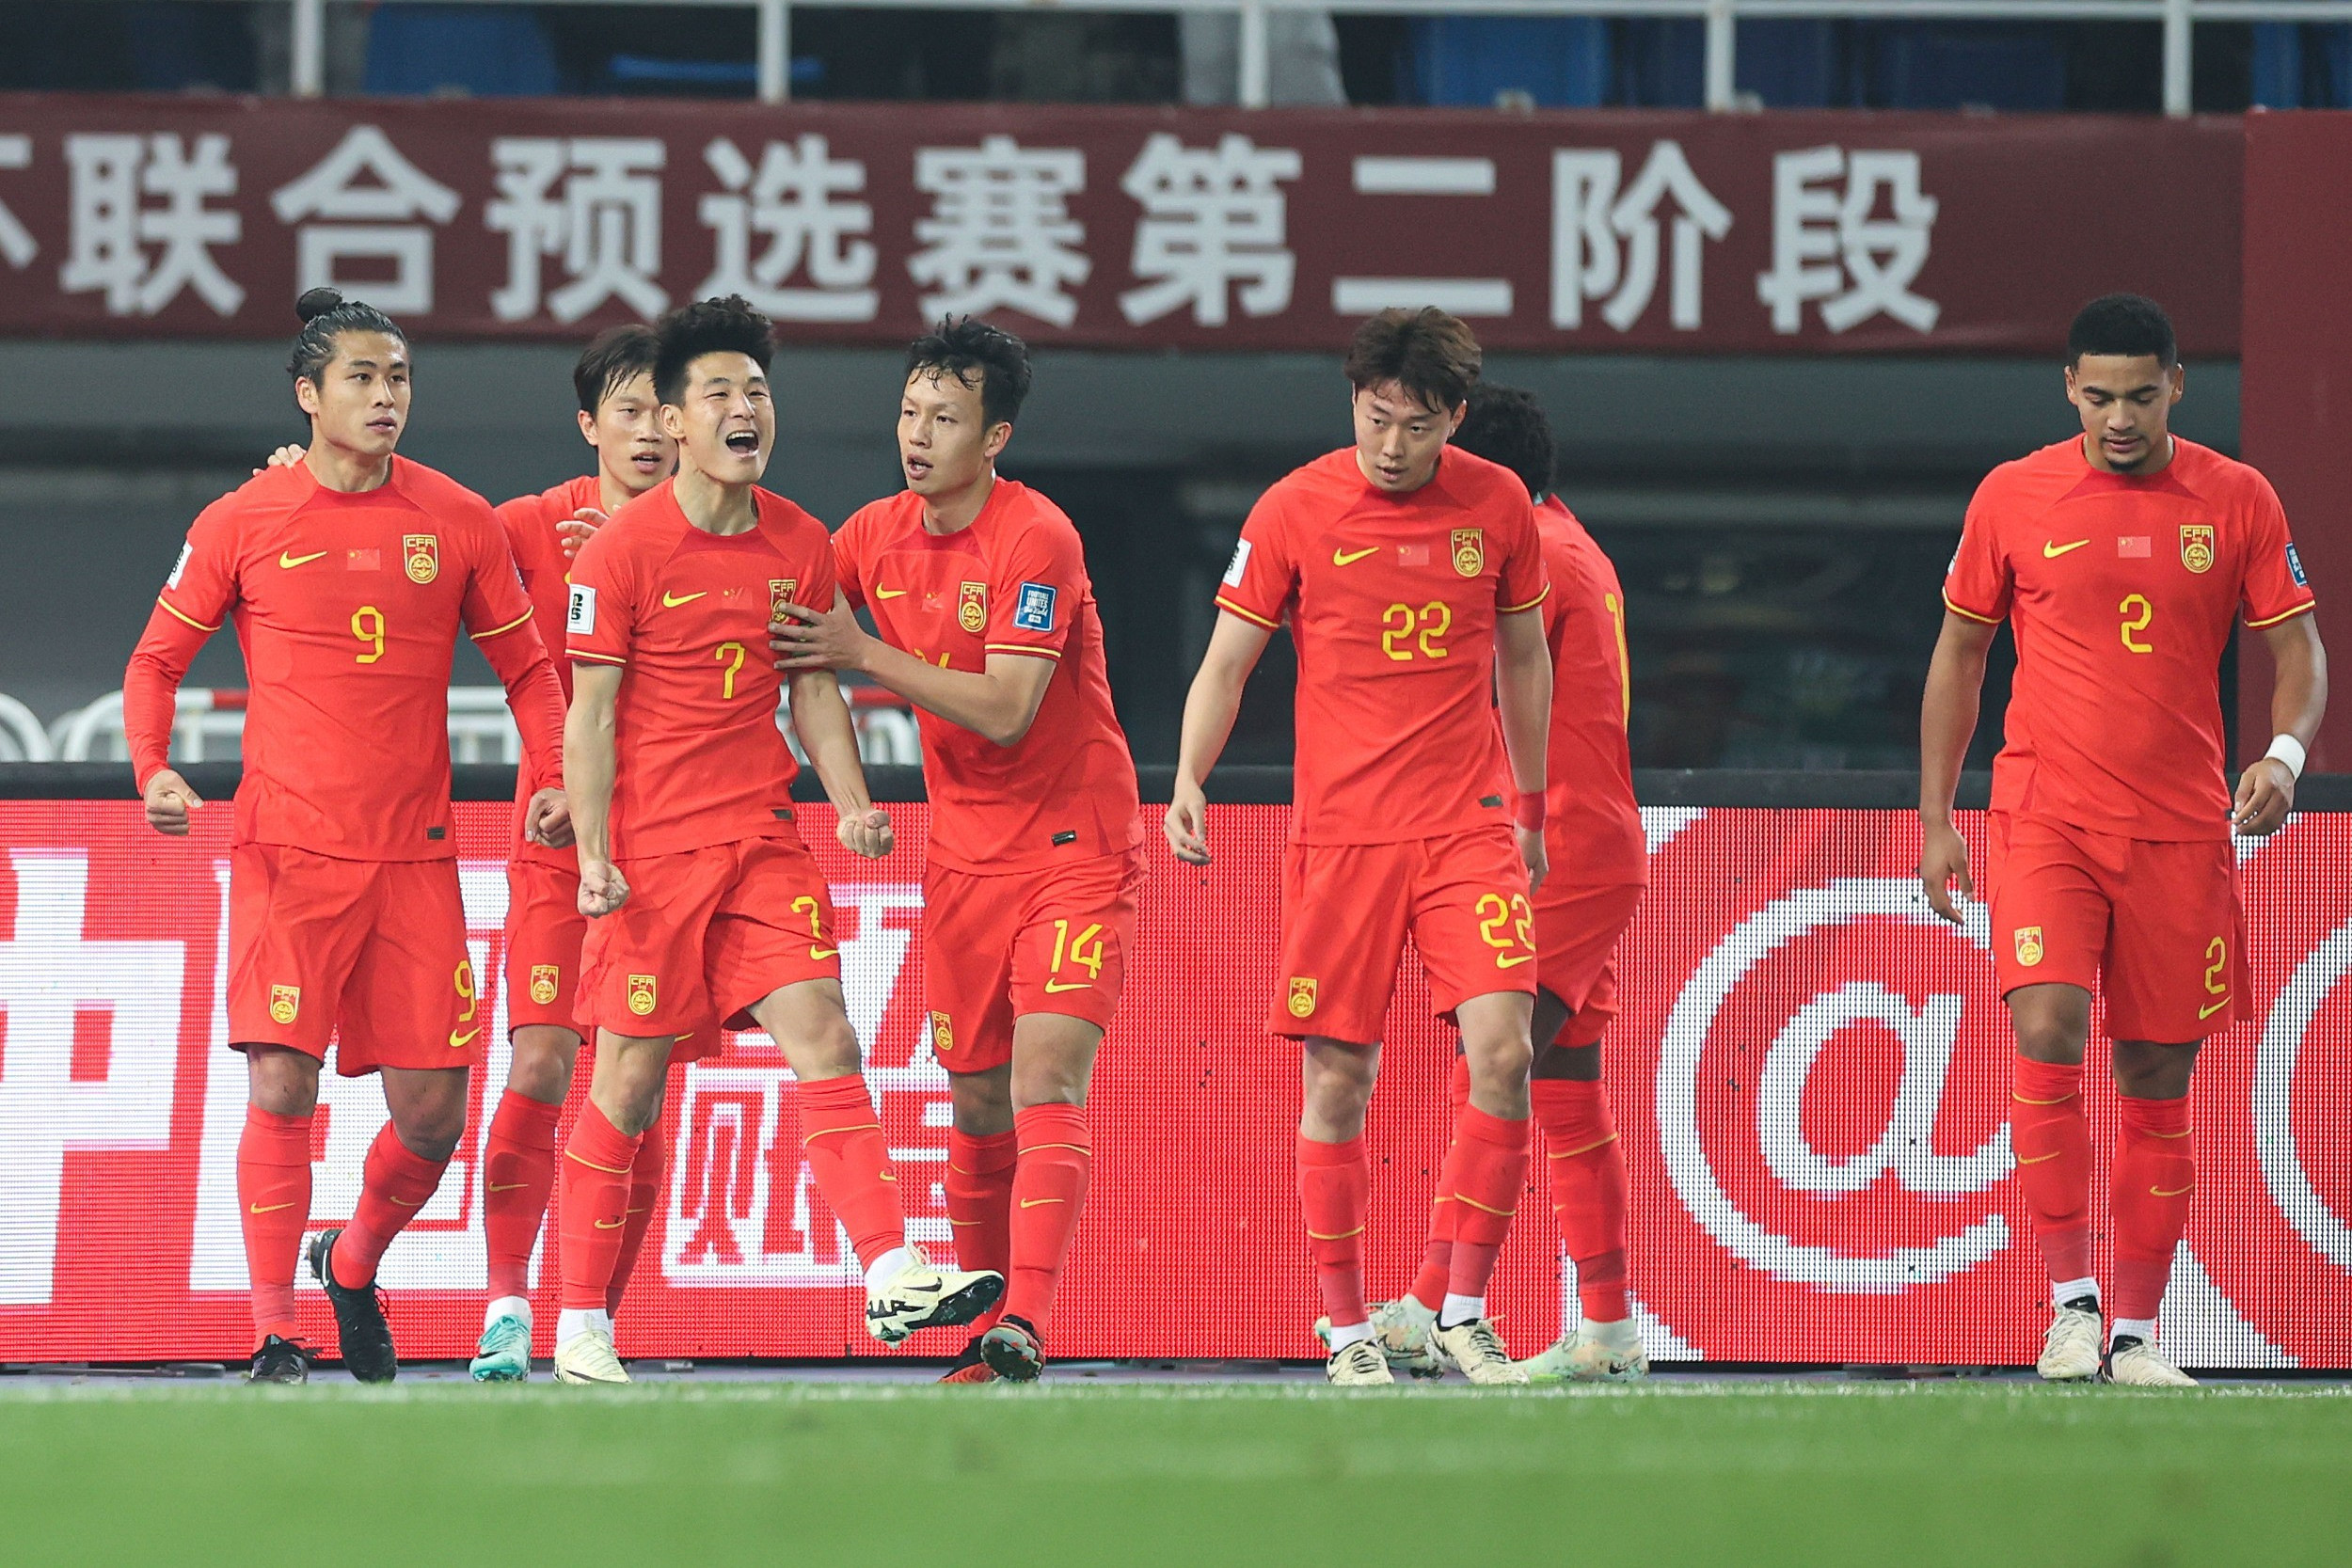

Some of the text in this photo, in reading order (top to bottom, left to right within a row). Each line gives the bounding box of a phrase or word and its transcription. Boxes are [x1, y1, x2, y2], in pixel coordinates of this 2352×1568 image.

[406, 537, 435, 547] CFA
[1454, 531, 1479, 542] CFA
[2183, 528, 2211, 538] CFA
[771, 582, 794, 593] CFA
[963, 584, 984, 596] CFA
[351, 606, 385, 664] 9
[1382, 600, 1453, 660] 22
[2119, 594, 2153, 653] 2
[715, 641, 745, 700] 7
[789, 895, 823, 940] 7
[1475, 893, 1535, 952] 22
[1050, 919, 1103, 980] 14
[2205, 936, 2227, 995] 2
[273, 987, 295, 998] CFA
[453, 960, 476, 1022] 9
[532, 968, 556, 977] CFA
[629, 977, 653, 986] CFA
